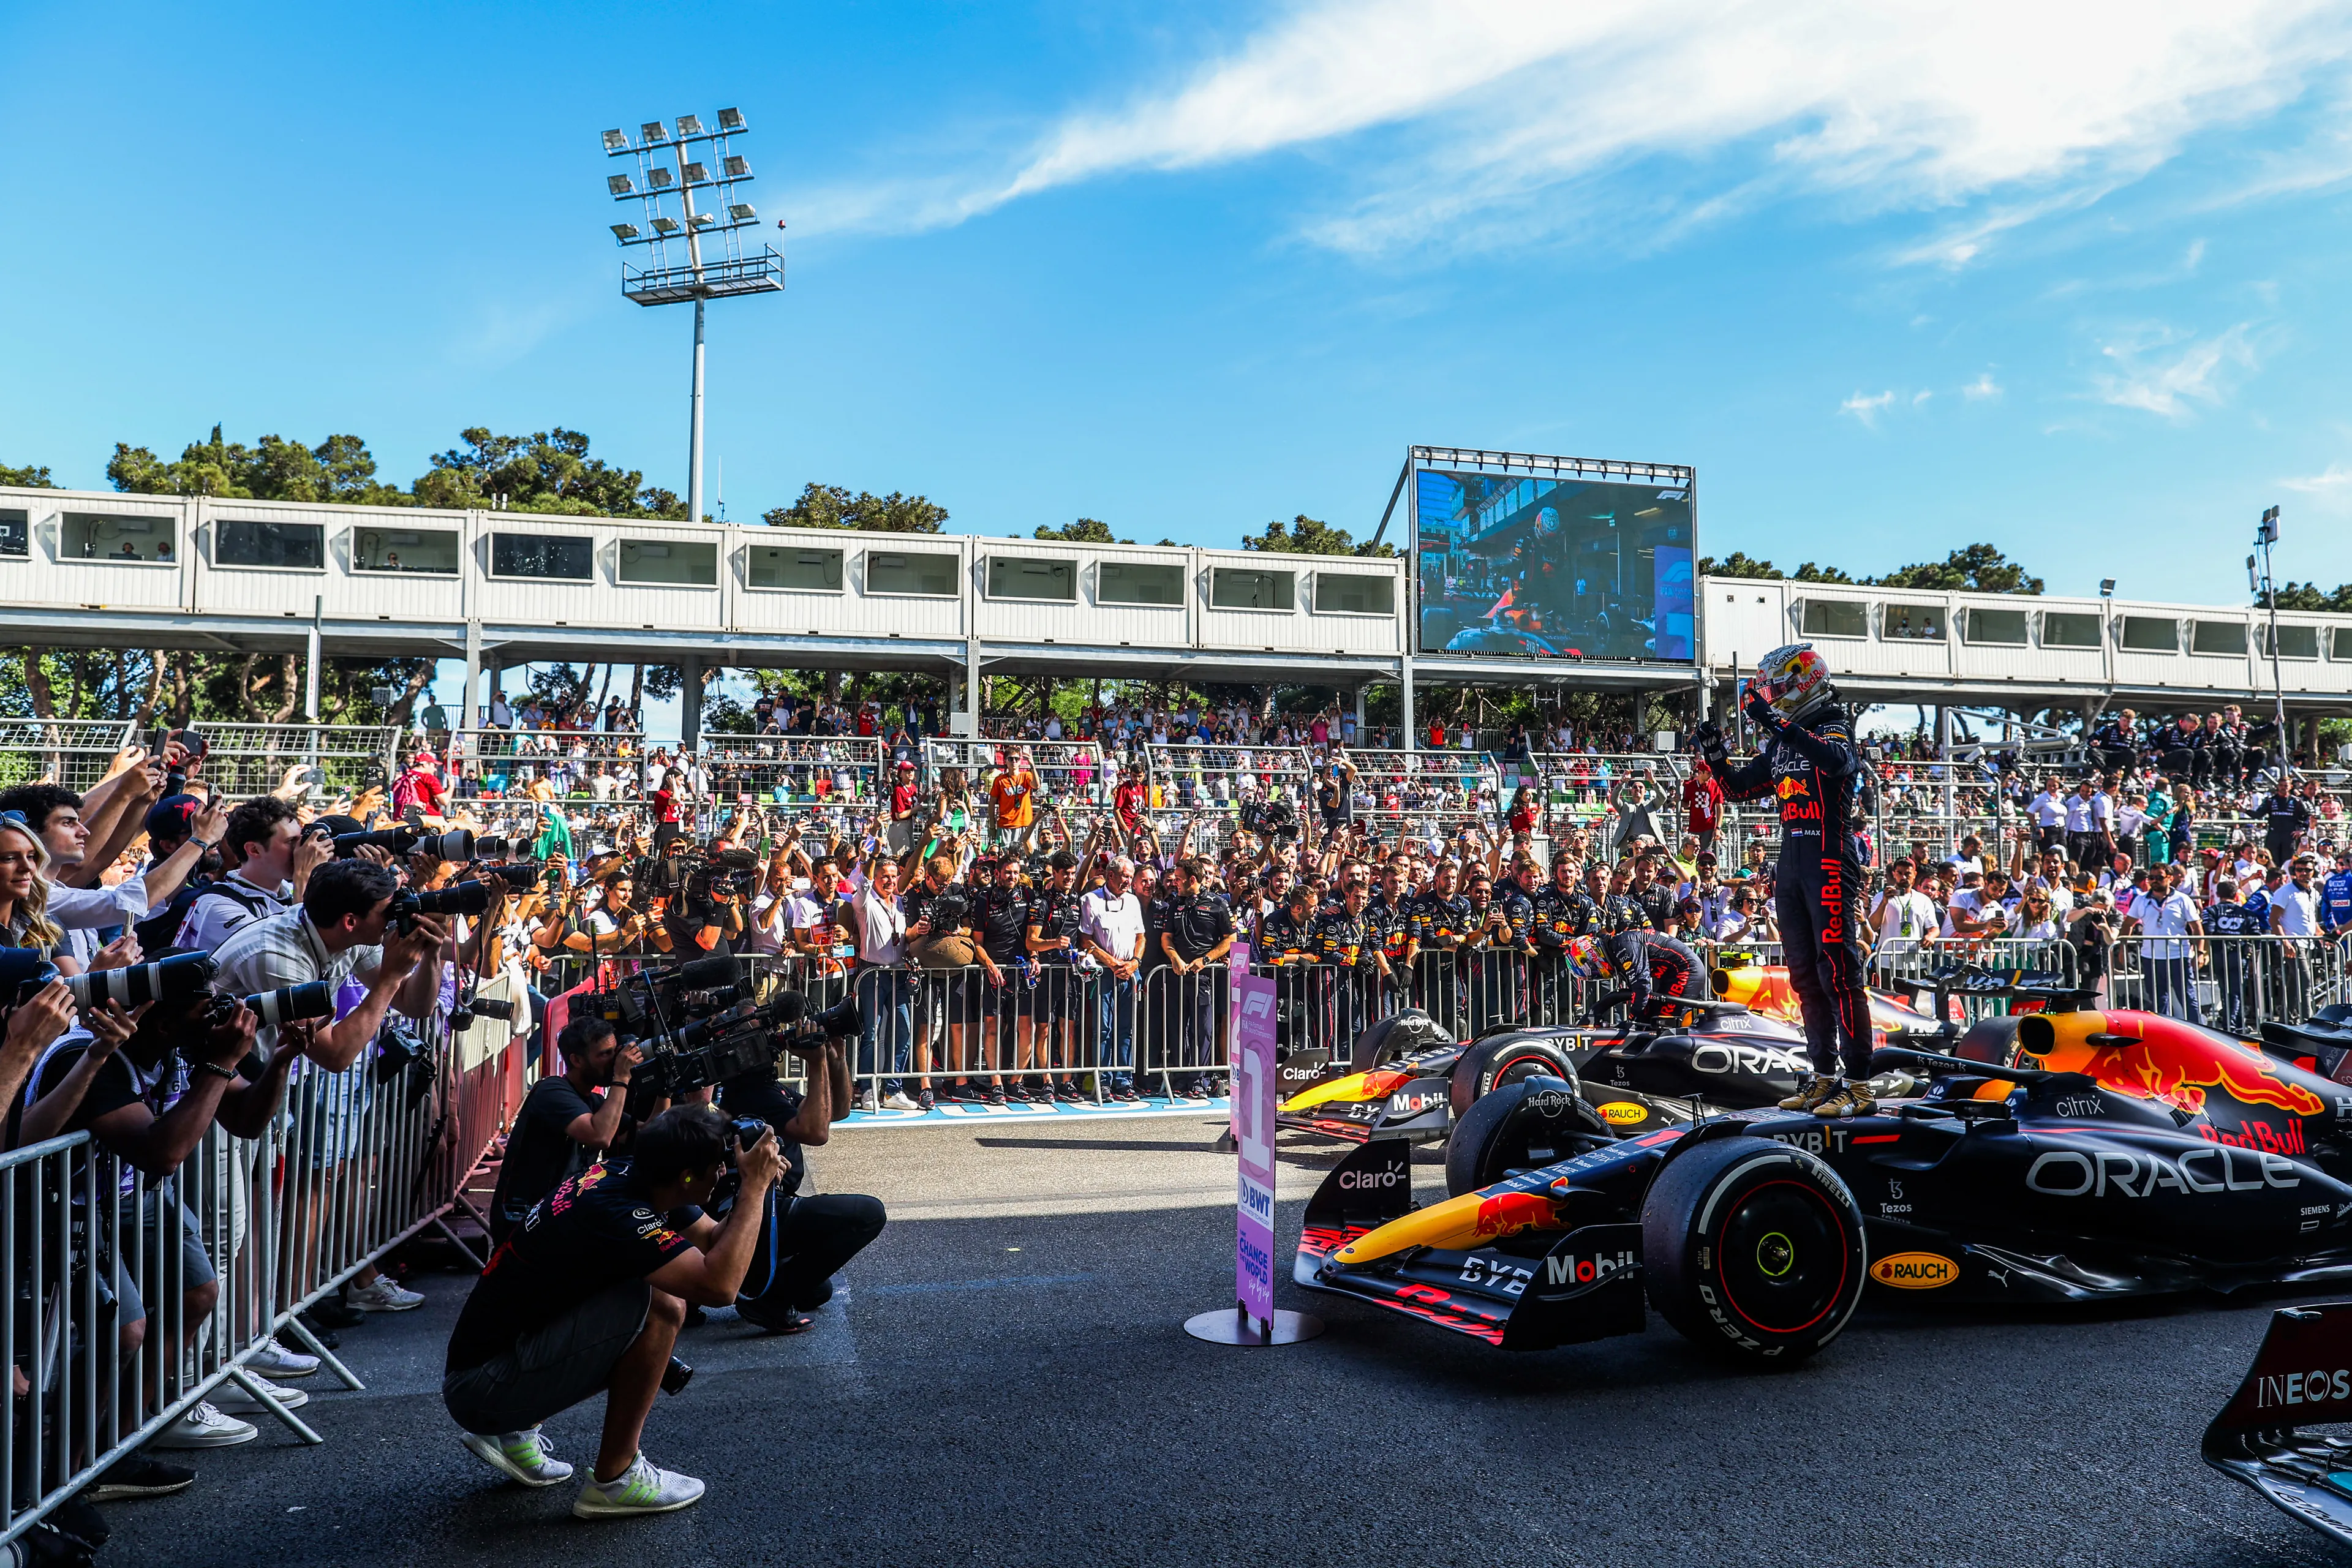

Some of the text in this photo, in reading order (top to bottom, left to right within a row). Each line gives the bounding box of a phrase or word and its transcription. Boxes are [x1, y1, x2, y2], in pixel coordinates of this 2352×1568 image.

[1231, 952, 1248, 968] F1
[1242, 990, 1274, 1019] F1
[1721, 1017, 1752, 1031] citrix
[1692, 1045, 1817, 1074] ORAC
[1927, 1058, 1955, 1070] Tezos
[1243, 1048, 1270, 1172] 1
[1393, 1092, 1443, 1111] Mobil
[1528, 1094, 1570, 1107] Hard Rock
[1608, 1109, 1640, 1118] RAUCH
[2056, 1095, 2105, 1117] citrix
[1811, 1163, 1852, 1208] PIRELLI
[2026, 1149, 2300, 1197] ORACLE
[1250, 1186, 1270, 1218] BWT
[1880, 1202, 1912, 1213] Tezos
[2301, 1204, 2330, 1215] SIEMENS
[1240, 1237, 1268, 1270] CHANGE
[1245, 1257, 1267, 1285] WORLD
[1547, 1251, 1634, 1286] Mobil
[1894, 1262, 1948, 1279] RAUCH
[1699, 1284, 1760, 1350] ZERO
[2257, 1370, 2350, 1408] INEOS
